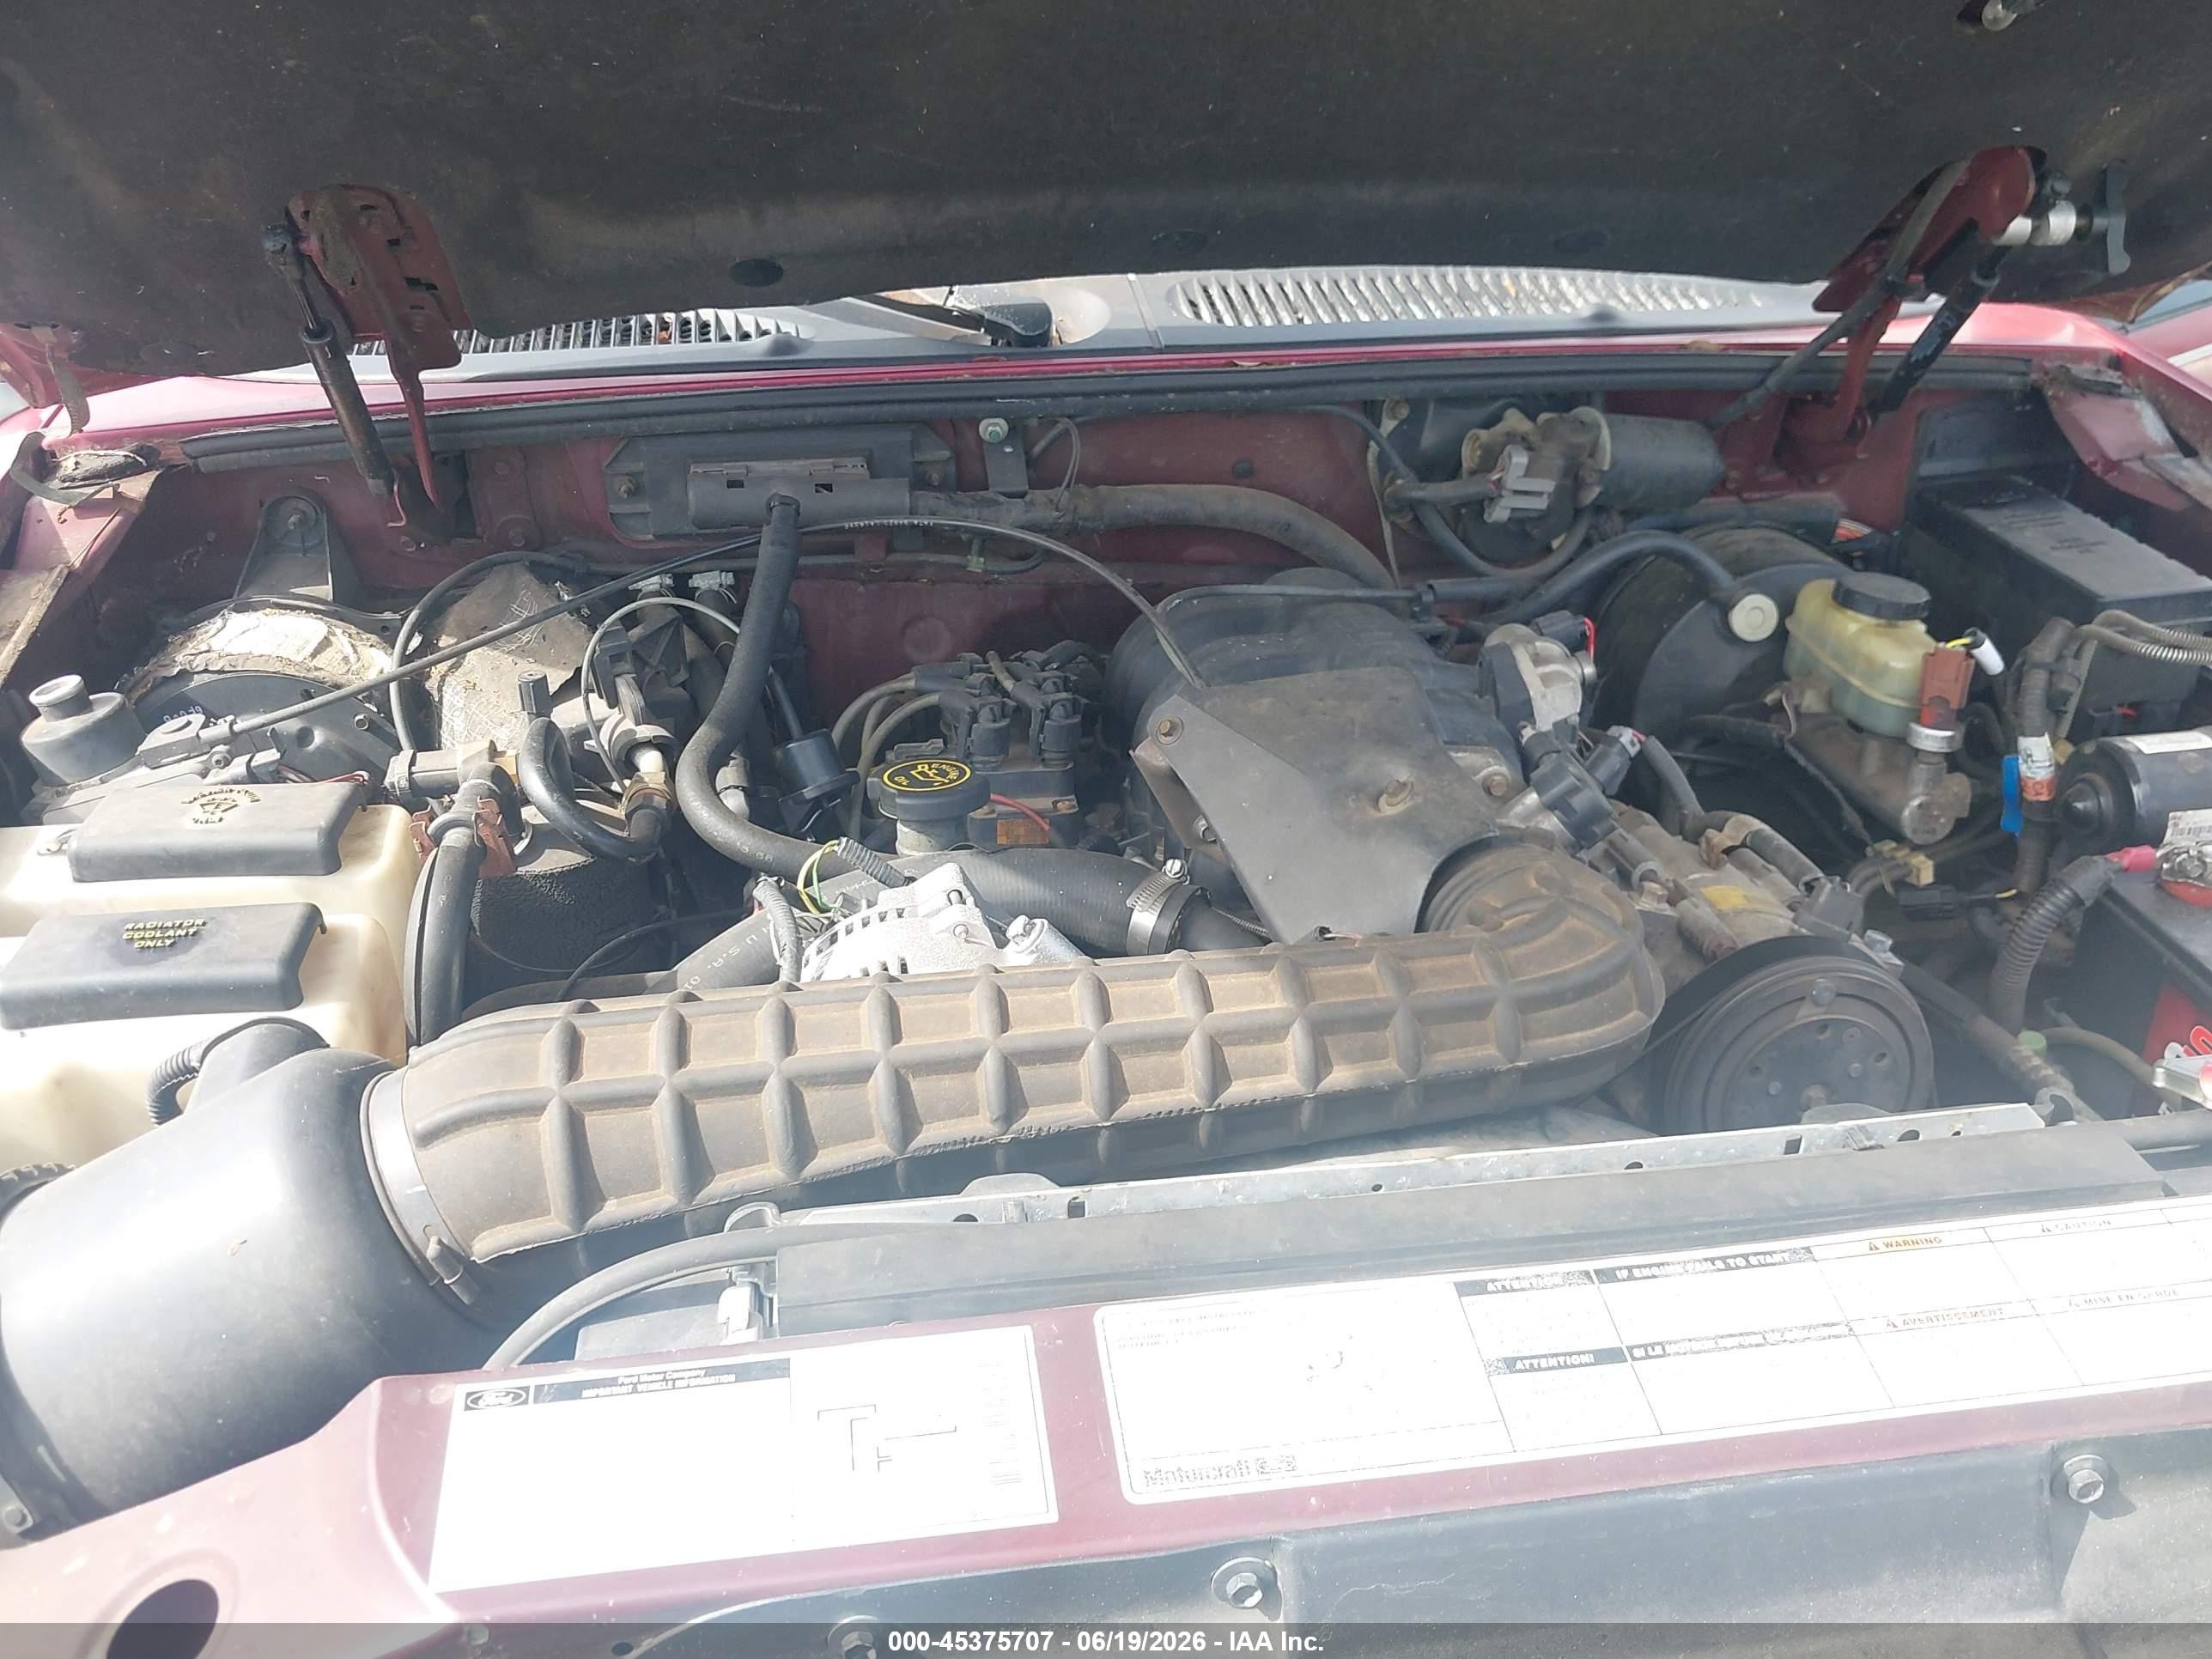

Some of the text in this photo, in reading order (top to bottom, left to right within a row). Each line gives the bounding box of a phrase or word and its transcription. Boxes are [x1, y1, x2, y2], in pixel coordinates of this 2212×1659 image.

[931, 763, 960, 780] ENGINE
[894, 775, 911, 786] OIL
[124, 918, 207, 931] RADIATOR
[122, 928, 198, 940] COOLANT
[133, 939, 176, 949] ONLY
[1882, 1236, 1942, 1249] WARNING
[1615, 1267, 1629, 1280] IF
[1727, 1256, 1747, 1268] TO
[1748, 1252, 1789, 1266] START
[1902, 1307, 2004, 1327] AVERTISSEMENT
[1514, 1352, 1595, 1370] ATTENTION!
[618, 1369, 705, 1385] Ford Motor Company
[637, 1379, 673, 1394] VEHICLE
[477, 1391, 514, 1407] Ford
